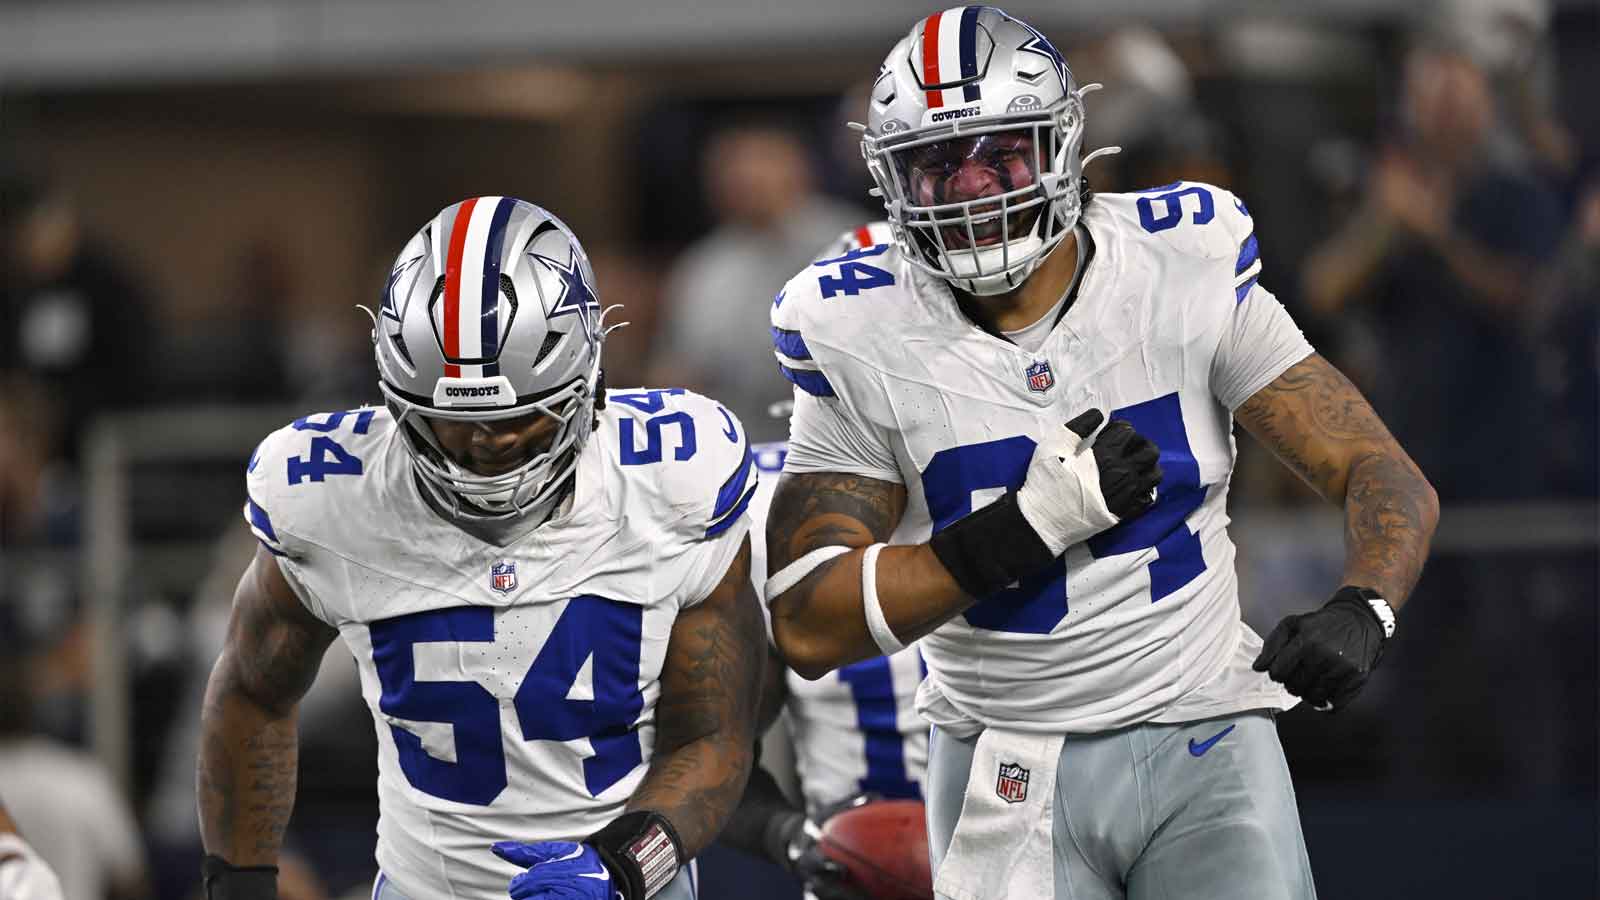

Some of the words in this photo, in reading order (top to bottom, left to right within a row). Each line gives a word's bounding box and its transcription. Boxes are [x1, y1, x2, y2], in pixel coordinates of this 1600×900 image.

[931, 107, 981, 122] COWBOYS
[1135, 180, 1215, 233] 9
[445, 385, 500, 397] COWBOYS
[1031, 373, 1052, 389] NFL
[607, 388, 697, 465] 54
[287, 410, 375, 486] 54
[370, 594, 643, 806] 54
[999, 777, 1025, 799] NFL
